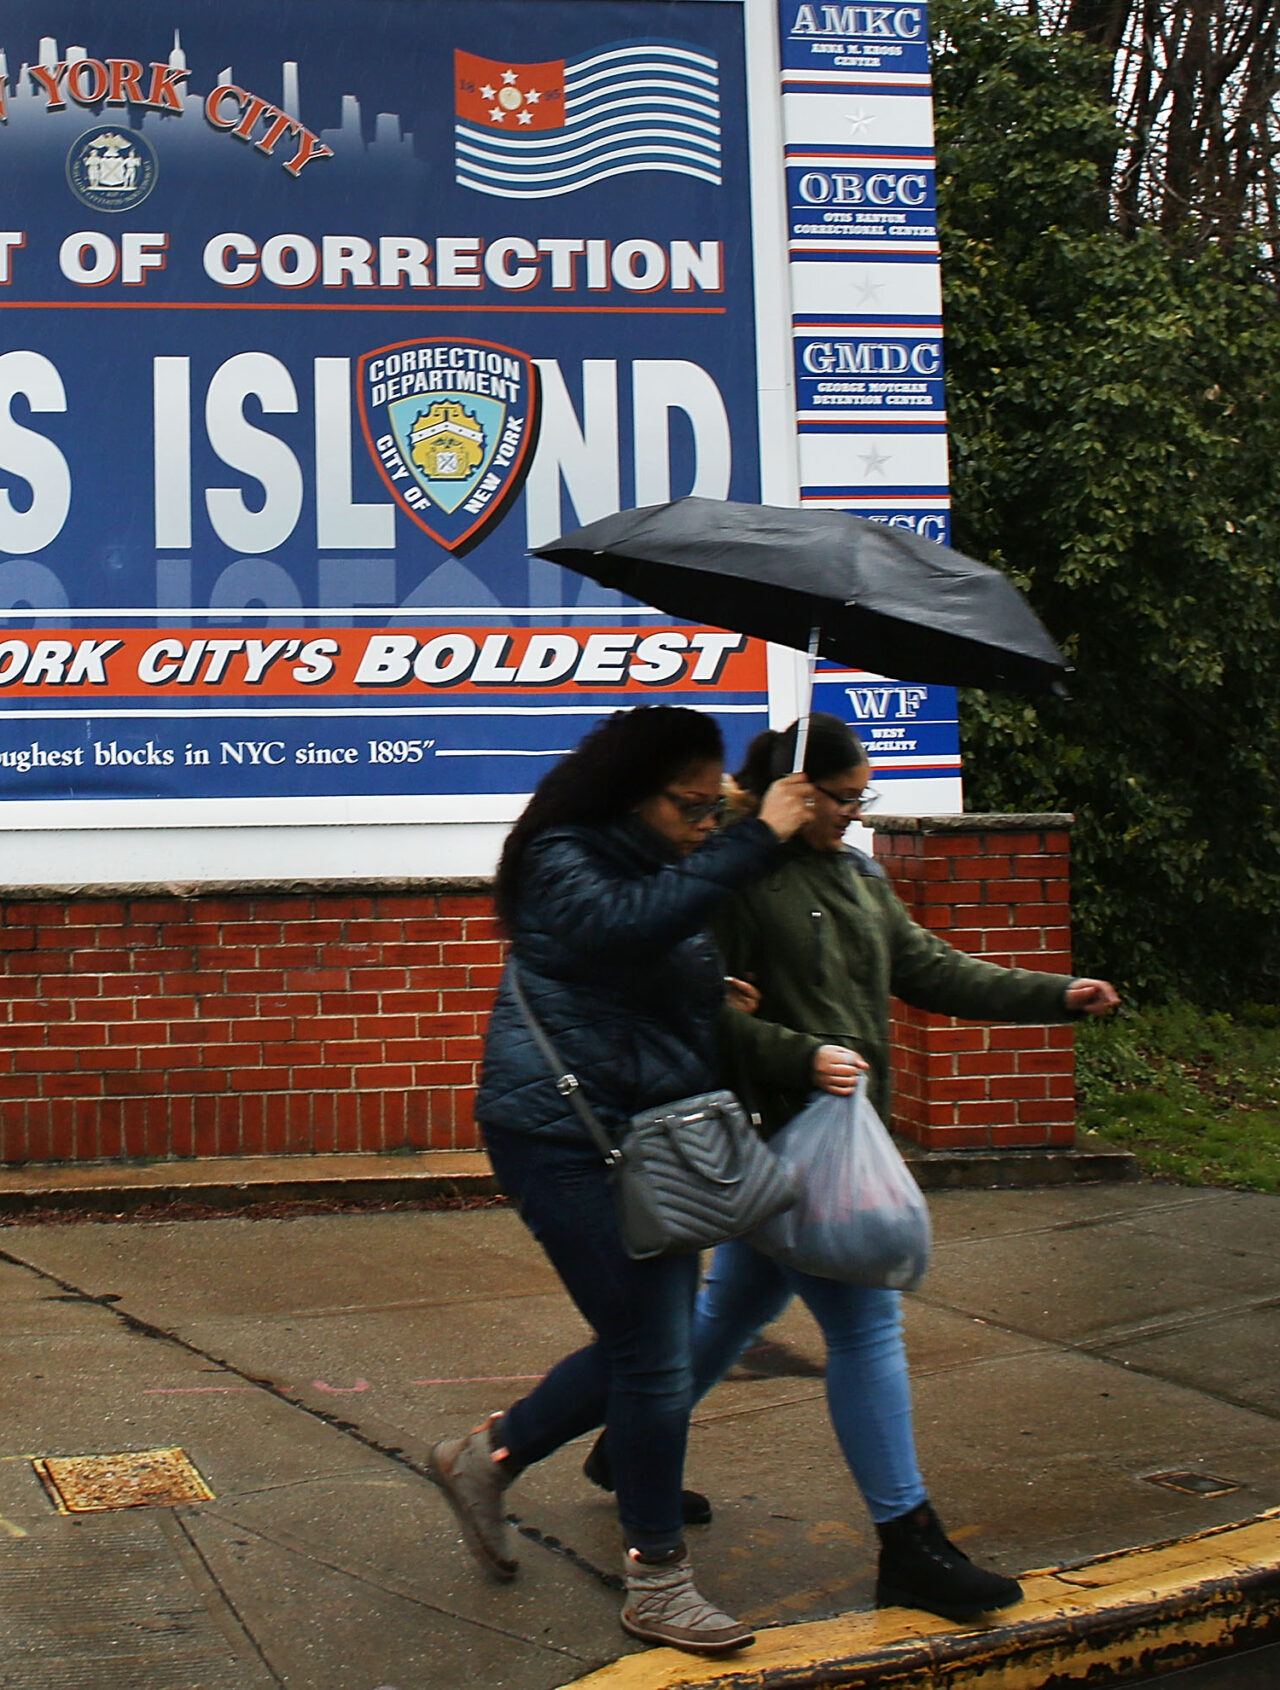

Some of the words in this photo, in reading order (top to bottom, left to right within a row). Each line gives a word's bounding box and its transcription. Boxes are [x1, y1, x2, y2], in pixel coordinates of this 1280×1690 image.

[791, 4, 921, 38] AMKC
[28, 58, 192, 114] YORK
[205, 84, 334, 178] CITY
[799, 172, 927, 205] OBCC
[59, 231, 168, 288] OF
[203, 233, 725, 292] CORRECTION
[370, 347, 521, 382] CORRECTION
[803, 342, 940, 374] GMDC
[372, 370, 521, 407] DEPARTMENT
[376, 433, 410, 481] CITY
[403, 487, 432, 511] OF
[463, 472, 502, 514] NEW
[493, 416, 525, 468] YORK
[137, 638, 340, 687] CITY'S
[353, 632, 749, 688] BOLDEST
[845, 687, 927, 719] WF
[93, 741, 175, 766] blocks
[184, 743, 211, 765] in
[220, 742, 286, 764] NYC
[295, 743, 359, 764] since
[368, 740, 435, 764] 1895"
